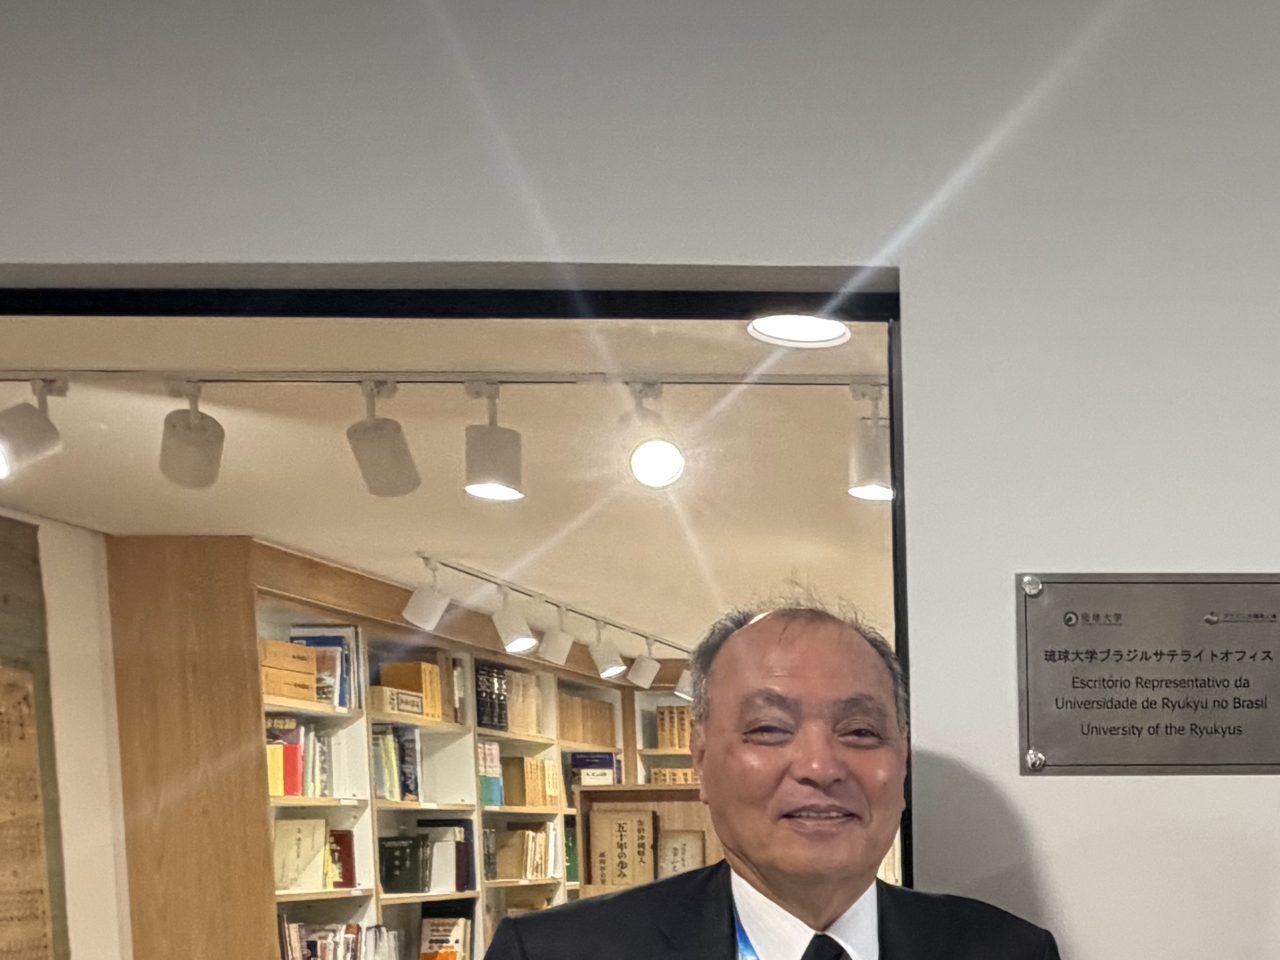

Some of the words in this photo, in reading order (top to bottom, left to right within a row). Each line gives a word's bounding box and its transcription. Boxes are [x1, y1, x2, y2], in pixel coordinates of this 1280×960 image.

[1044, 649, 1274, 663] 琉球大学ブラジルサテライトオフィス
[1072, 675, 1131, 689] Escritório
[1136, 676, 1230, 692] Representativo
[1234, 676, 1250, 689] da
[1055, 697, 1137, 710] Universidade
[1141, 697, 1158, 710] de
[1162, 697, 1208, 713] Ryukyu
[1213, 699, 1229, 710] no
[1233, 696, 1268, 710] Brasil
[1081, 723, 1143, 738] University
[1147, 722, 1162, 736] of
[1165, 722, 1186, 736] the
[1190, 723, 1243, 738] Ryukyus
